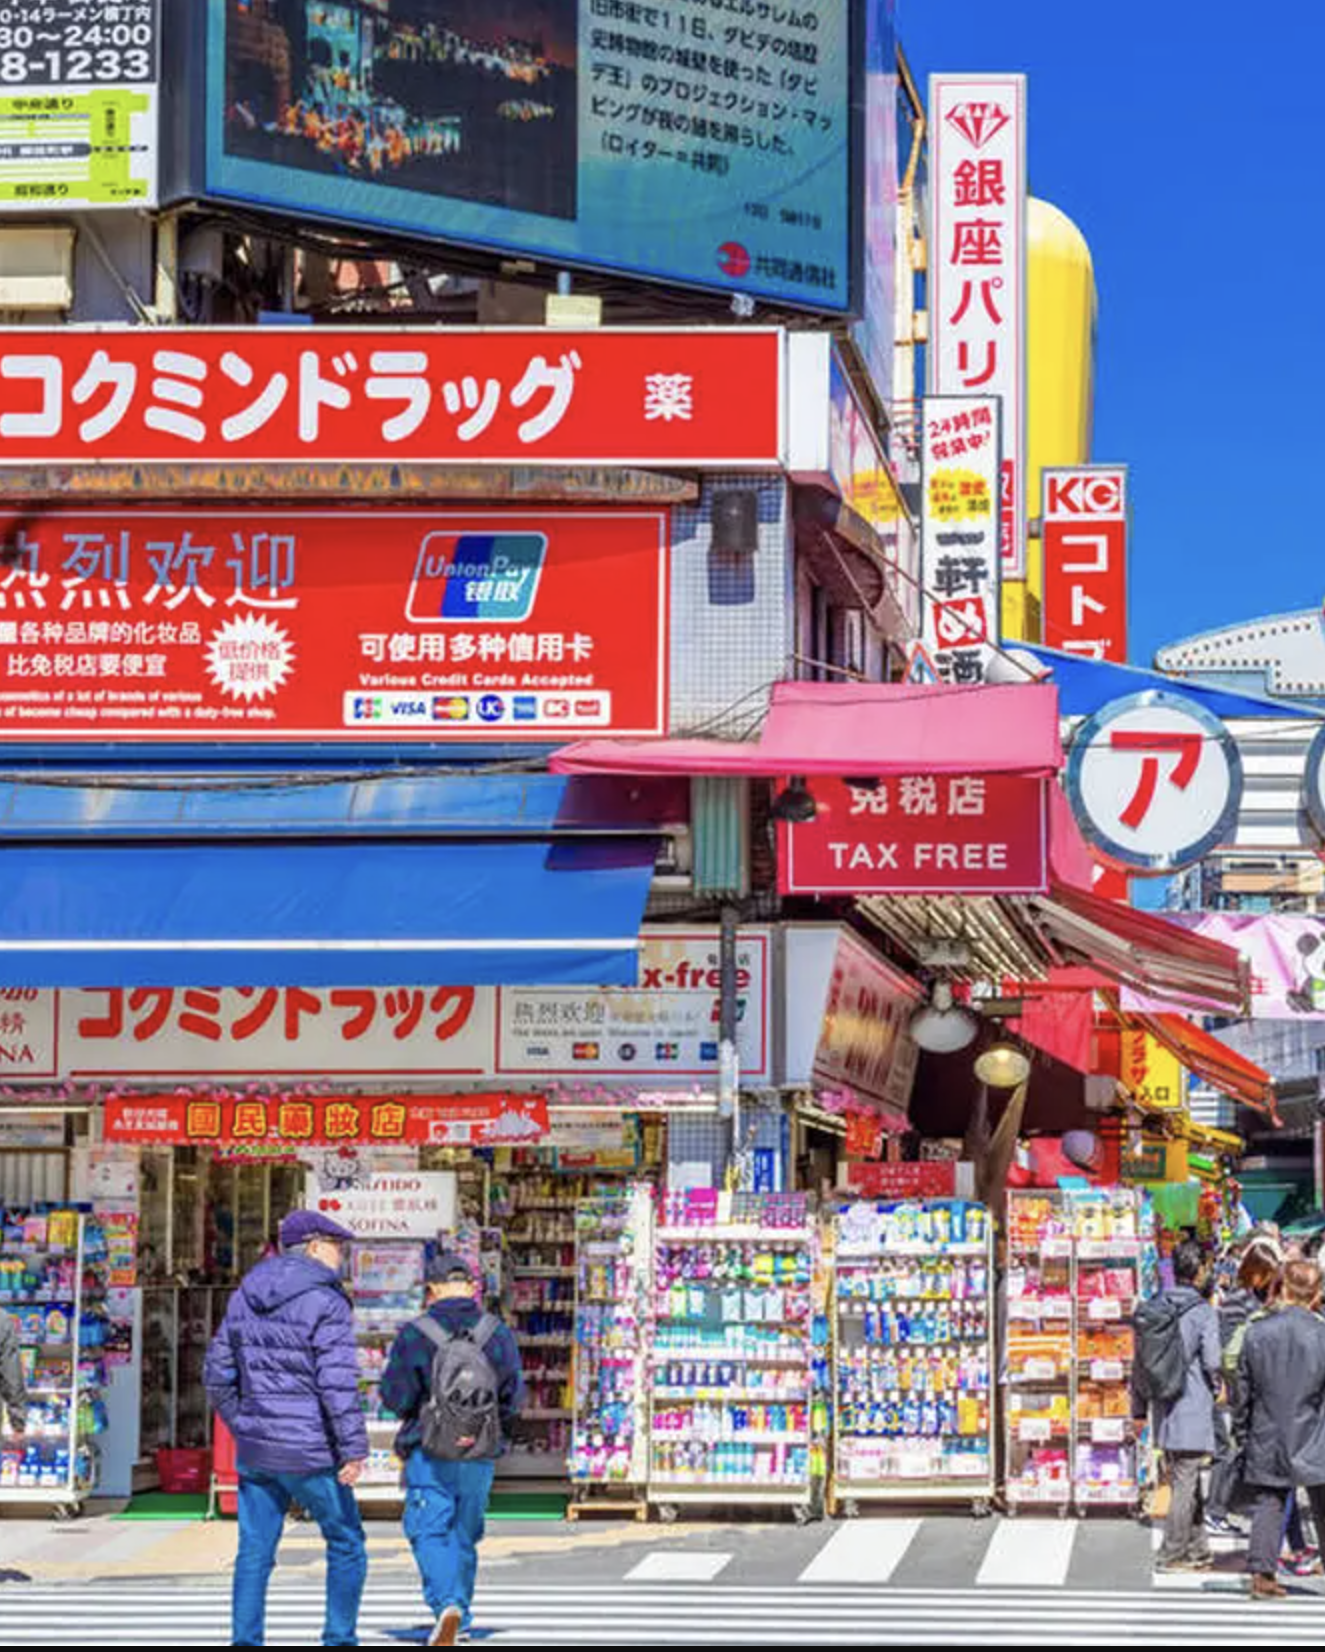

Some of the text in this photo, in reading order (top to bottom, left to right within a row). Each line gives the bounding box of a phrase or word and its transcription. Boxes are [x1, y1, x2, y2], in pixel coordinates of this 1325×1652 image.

[0, 49, 149, 81] 8-1233
[949, 159, 1005, 388] 銀座パリ
[0, 350, 693, 443] コクミンドラッグ 薬
[425, 555, 531, 586] UnionPay
[359, 672, 594, 688] Various Credit Cards Accepted
[390, 701, 426, 716] VISA
[828, 843, 1007, 869] TAX FREE
